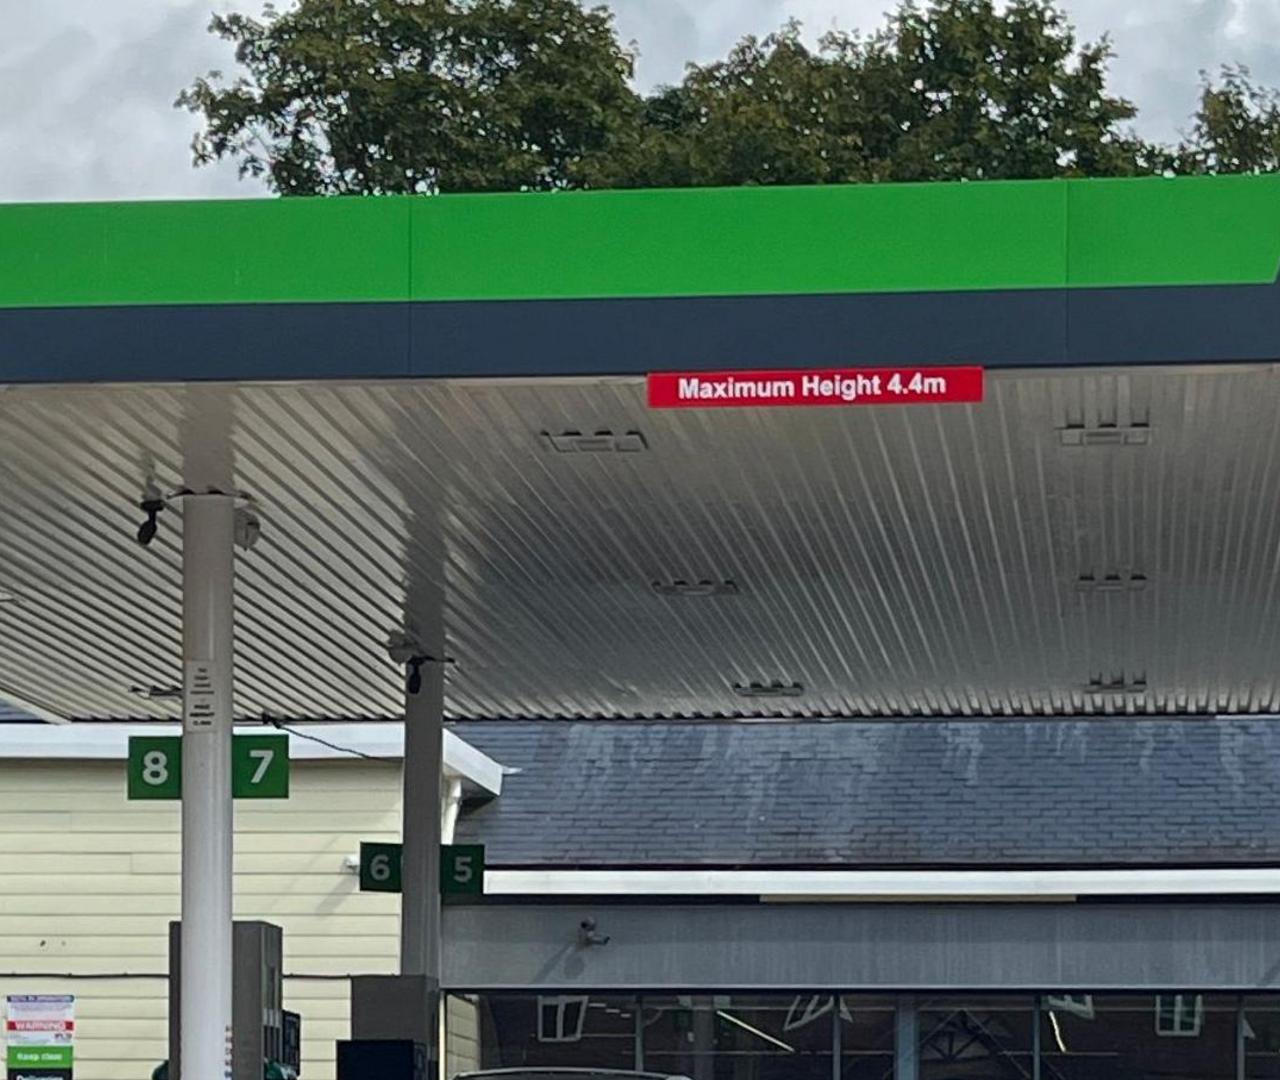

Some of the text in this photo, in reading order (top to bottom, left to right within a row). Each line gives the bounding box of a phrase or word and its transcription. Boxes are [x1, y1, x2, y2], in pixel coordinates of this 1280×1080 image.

[677, 373, 947, 401] Maximum Height 4.4m
[142, 750, 169, 785] 8
[249, 749, 274, 784] 7
[370, 854, 391, 881] 6
[453, 856, 473, 883] 5
